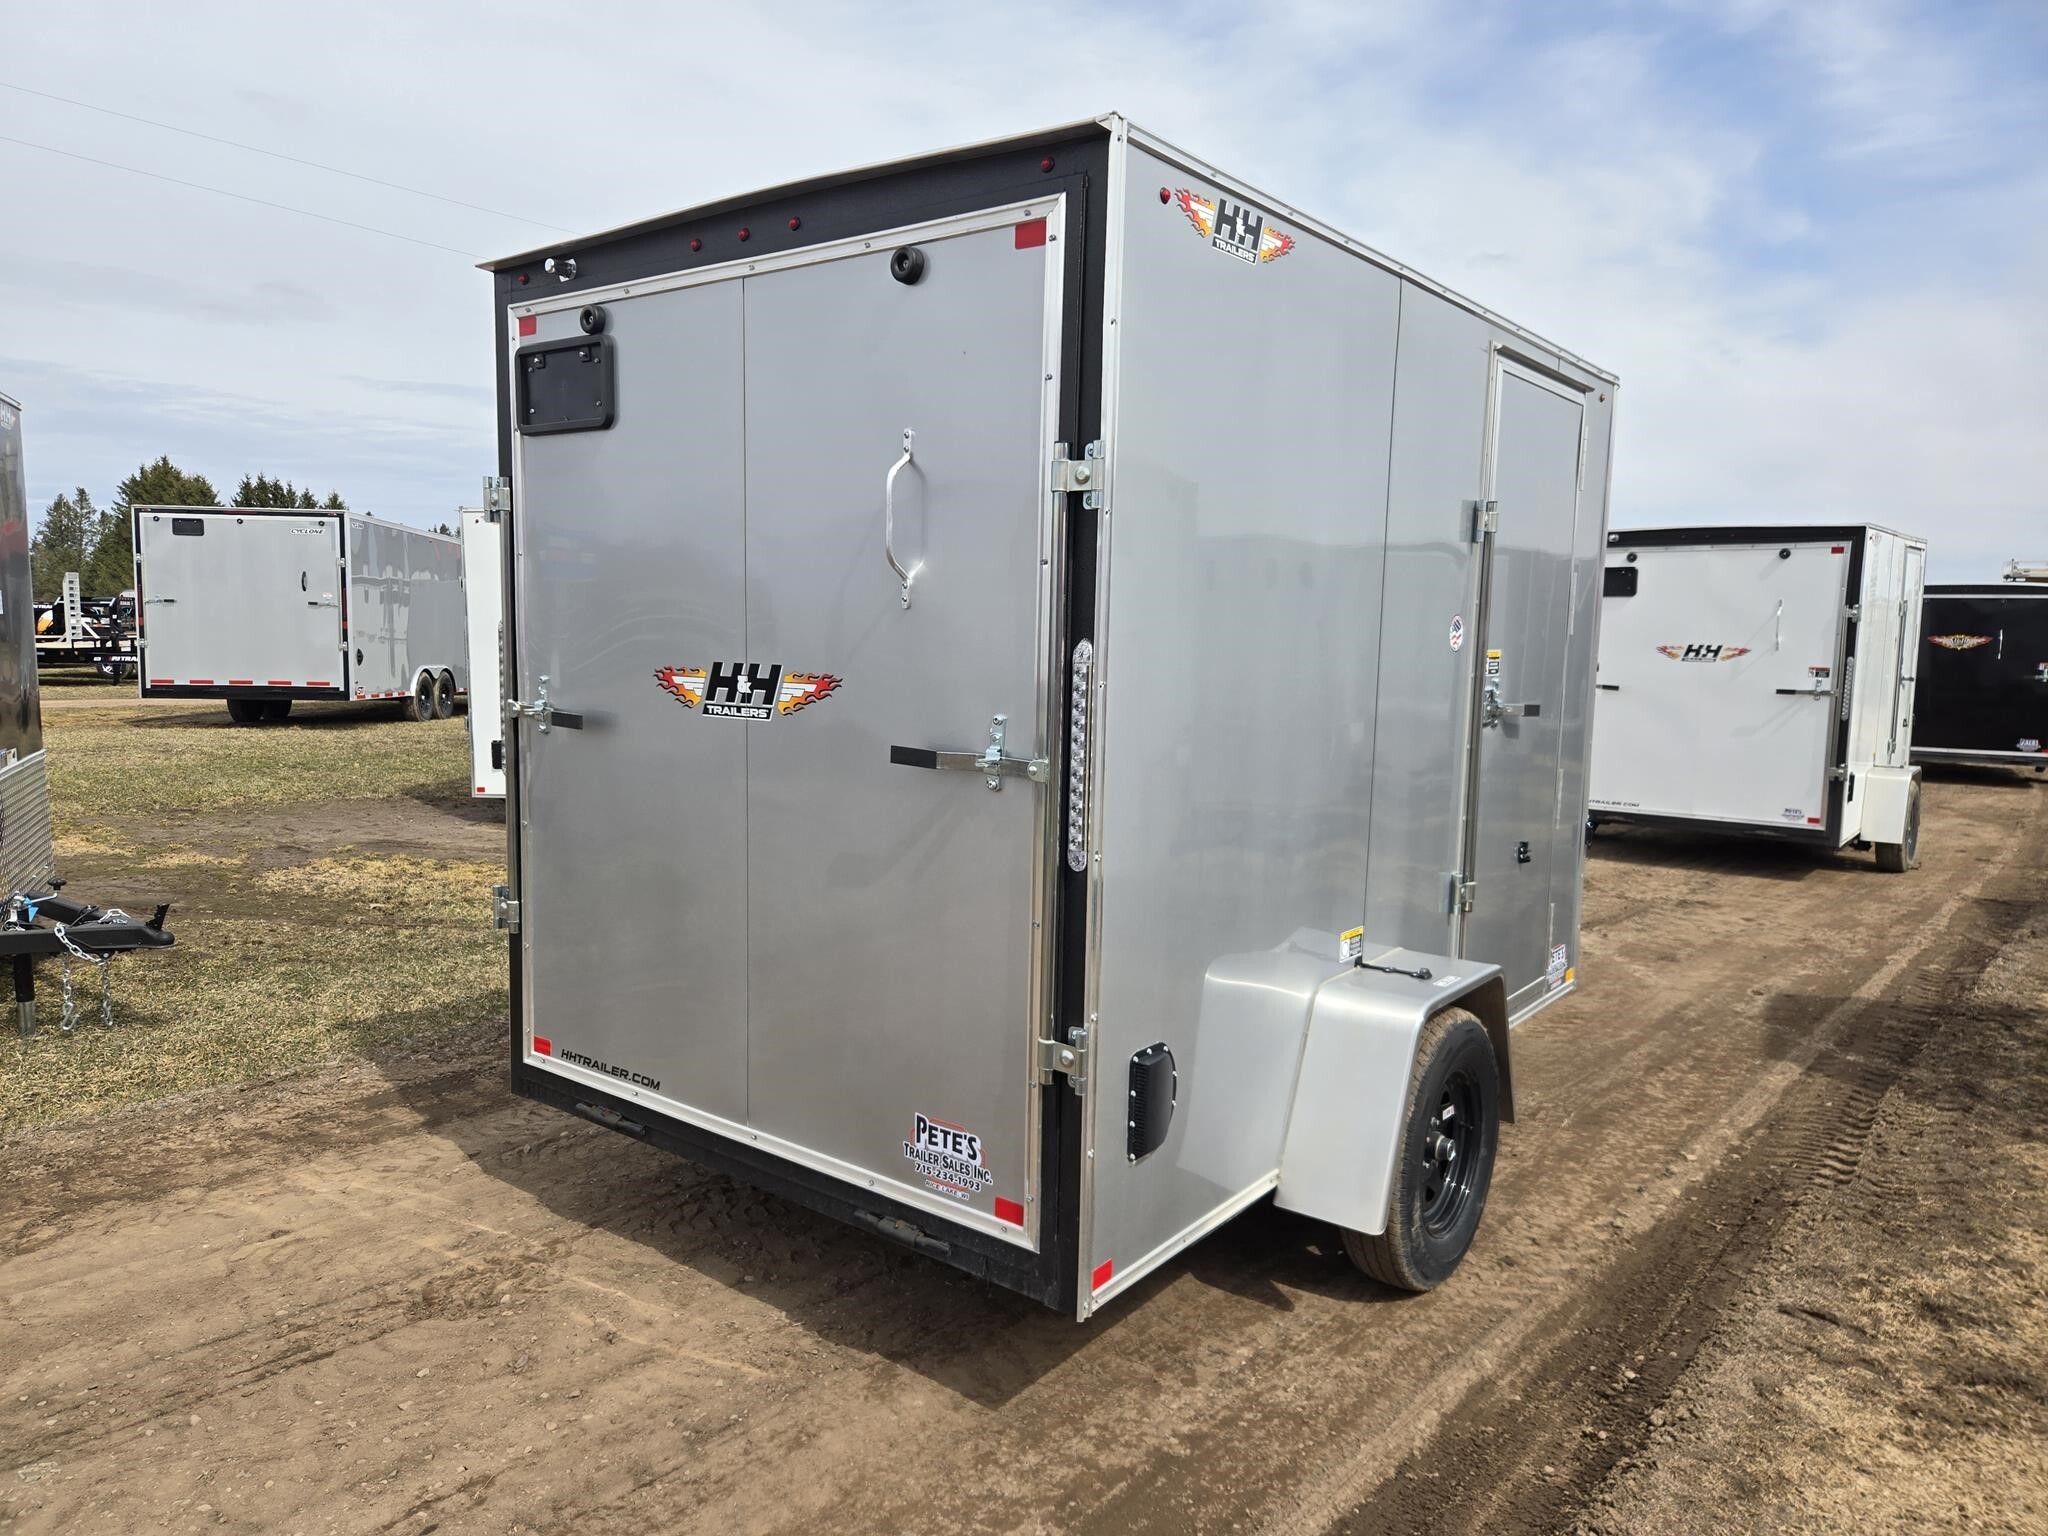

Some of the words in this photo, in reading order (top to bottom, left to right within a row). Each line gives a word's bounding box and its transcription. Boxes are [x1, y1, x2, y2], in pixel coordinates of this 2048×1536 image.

[1214, 239, 1255, 262] TRAILERS
[705, 661, 783, 706] H&H
[706, 704, 768, 718] TRAILERS
[561, 1049, 660, 1090] HHTRAILER.COM
[916, 1114, 978, 1161] PETE'S
[903, 1142, 939, 1166] TRAILER
[942, 1155, 971, 1176] SALES
[973, 1164, 993, 1184] INC.
[916, 1162, 981, 1191] 715-234-1993
